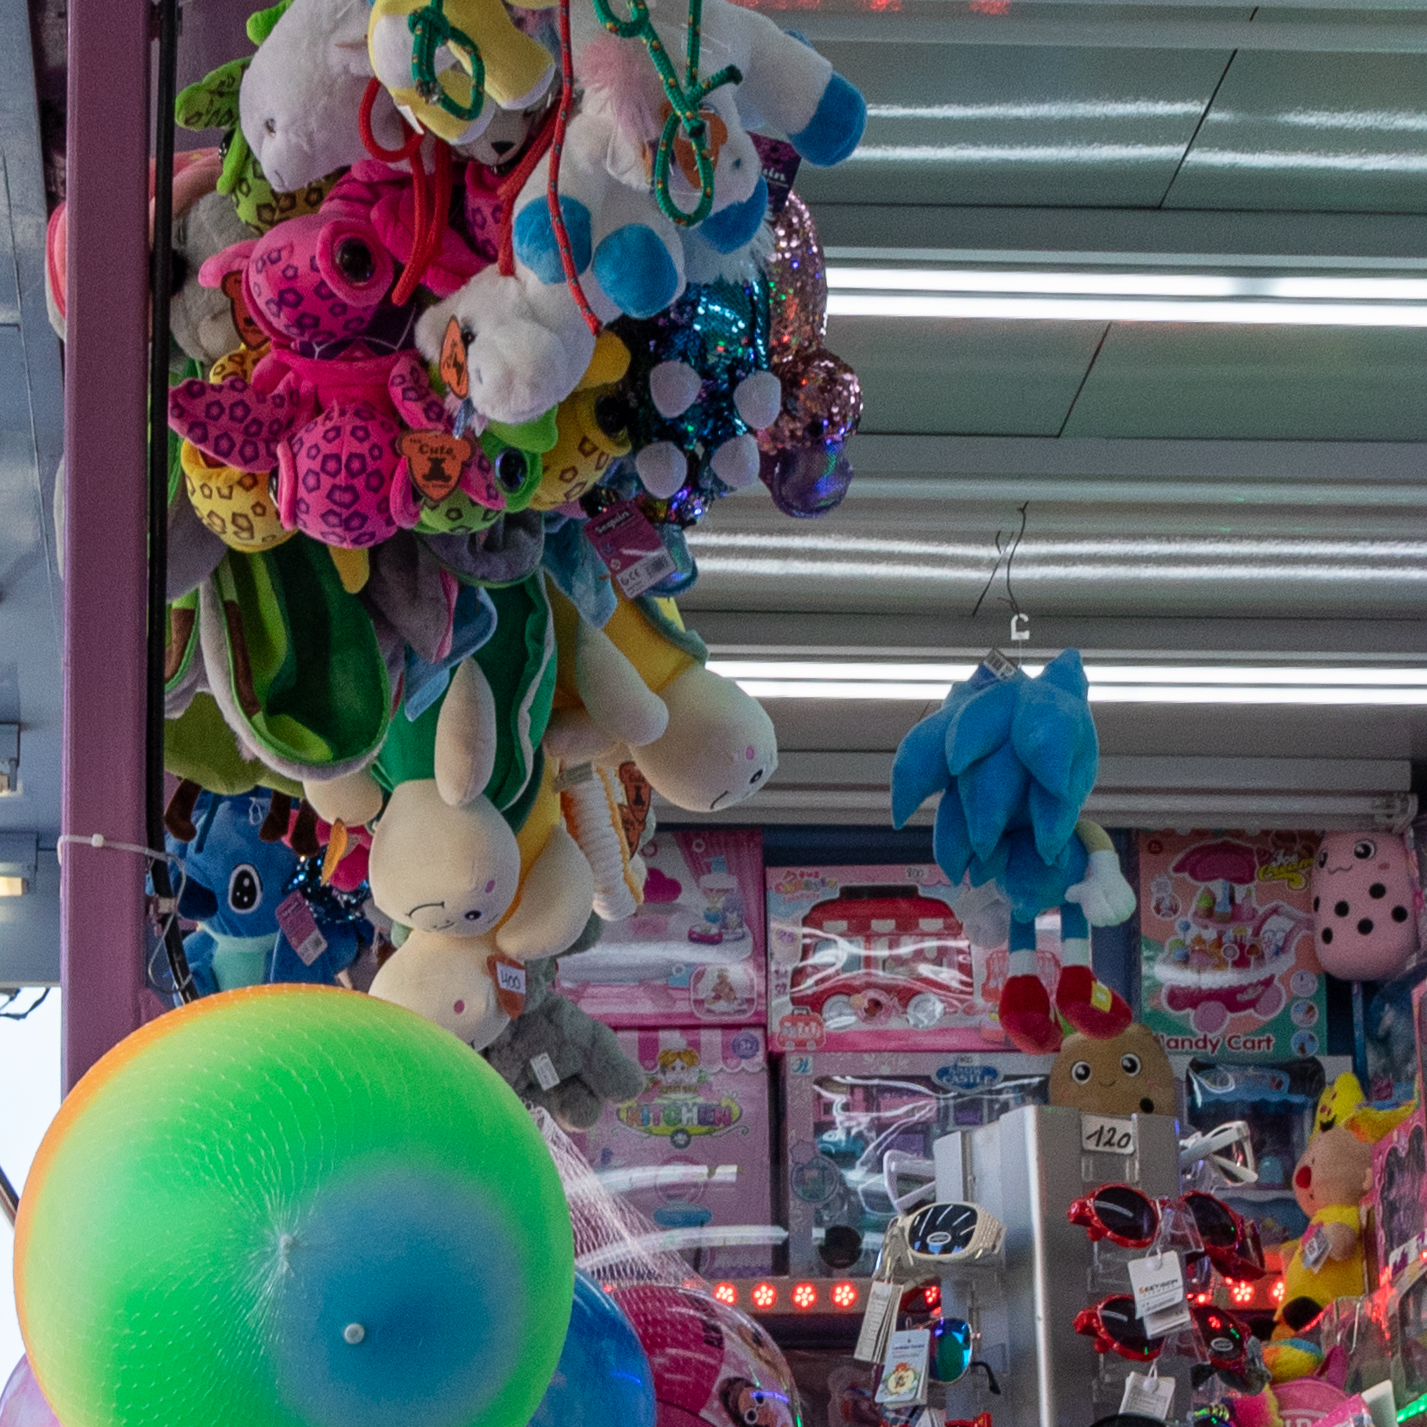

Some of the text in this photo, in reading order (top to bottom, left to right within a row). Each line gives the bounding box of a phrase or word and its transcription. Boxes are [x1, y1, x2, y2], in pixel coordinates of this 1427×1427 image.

[500, 971, 522, 991] 400
[1226, 1033, 1274, 1052] Cart
[625, 1105, 734, 1127] KITCHEN
[1085, 1123, 1132, 1149] 120
